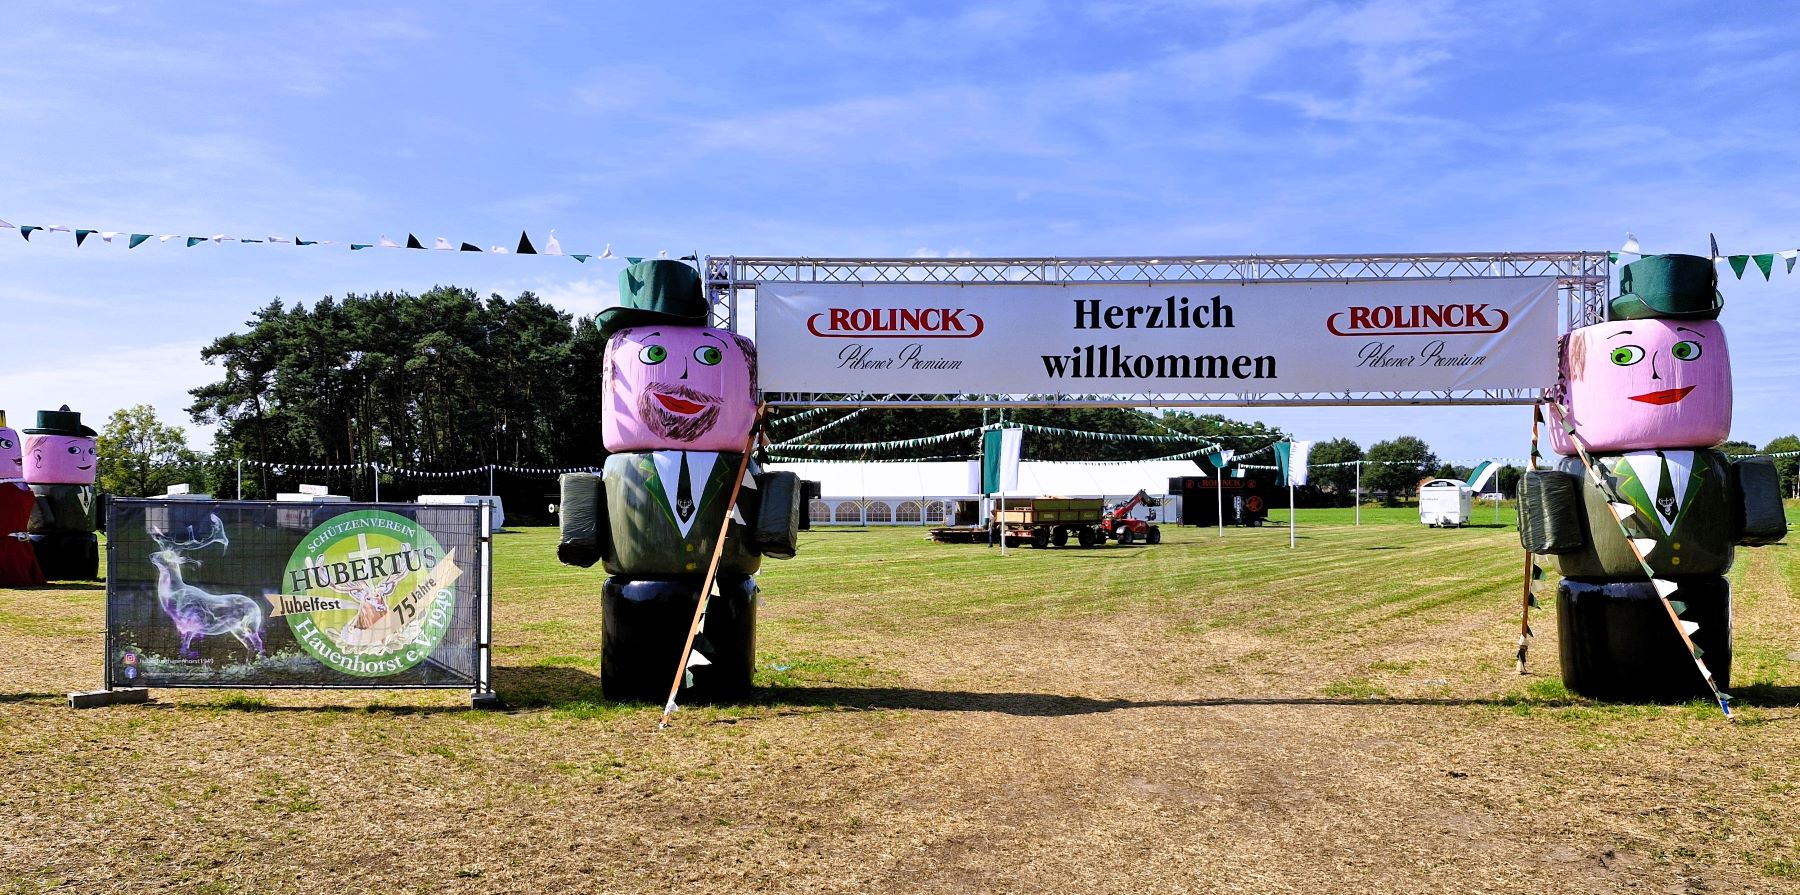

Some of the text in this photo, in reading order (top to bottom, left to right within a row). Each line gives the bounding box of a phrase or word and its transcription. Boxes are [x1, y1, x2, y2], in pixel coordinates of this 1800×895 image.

[828, 308, 966, 331] ROLINCK
[1073, 295, 1235, 329] Herzlich
[1348, 303, 1492, 329] ROLINCK
[837, 343, 963, 370] Pilsener Premium
[1040, 344, 1278, 379] willkommen
[1356, 340, 1486, 368] Pilsener Premium
[307, 518, 416, 553] SCHÜTZENVEREIN
[289, 546, 437, 592] HUBERTUS
[280, 595, 341, 615] Jubelfest
[393, 577, 437, 626] 75 Jahre
[295, 617, 403, 673] Hauenhorst
[429, 588, 452, 629] 1949
